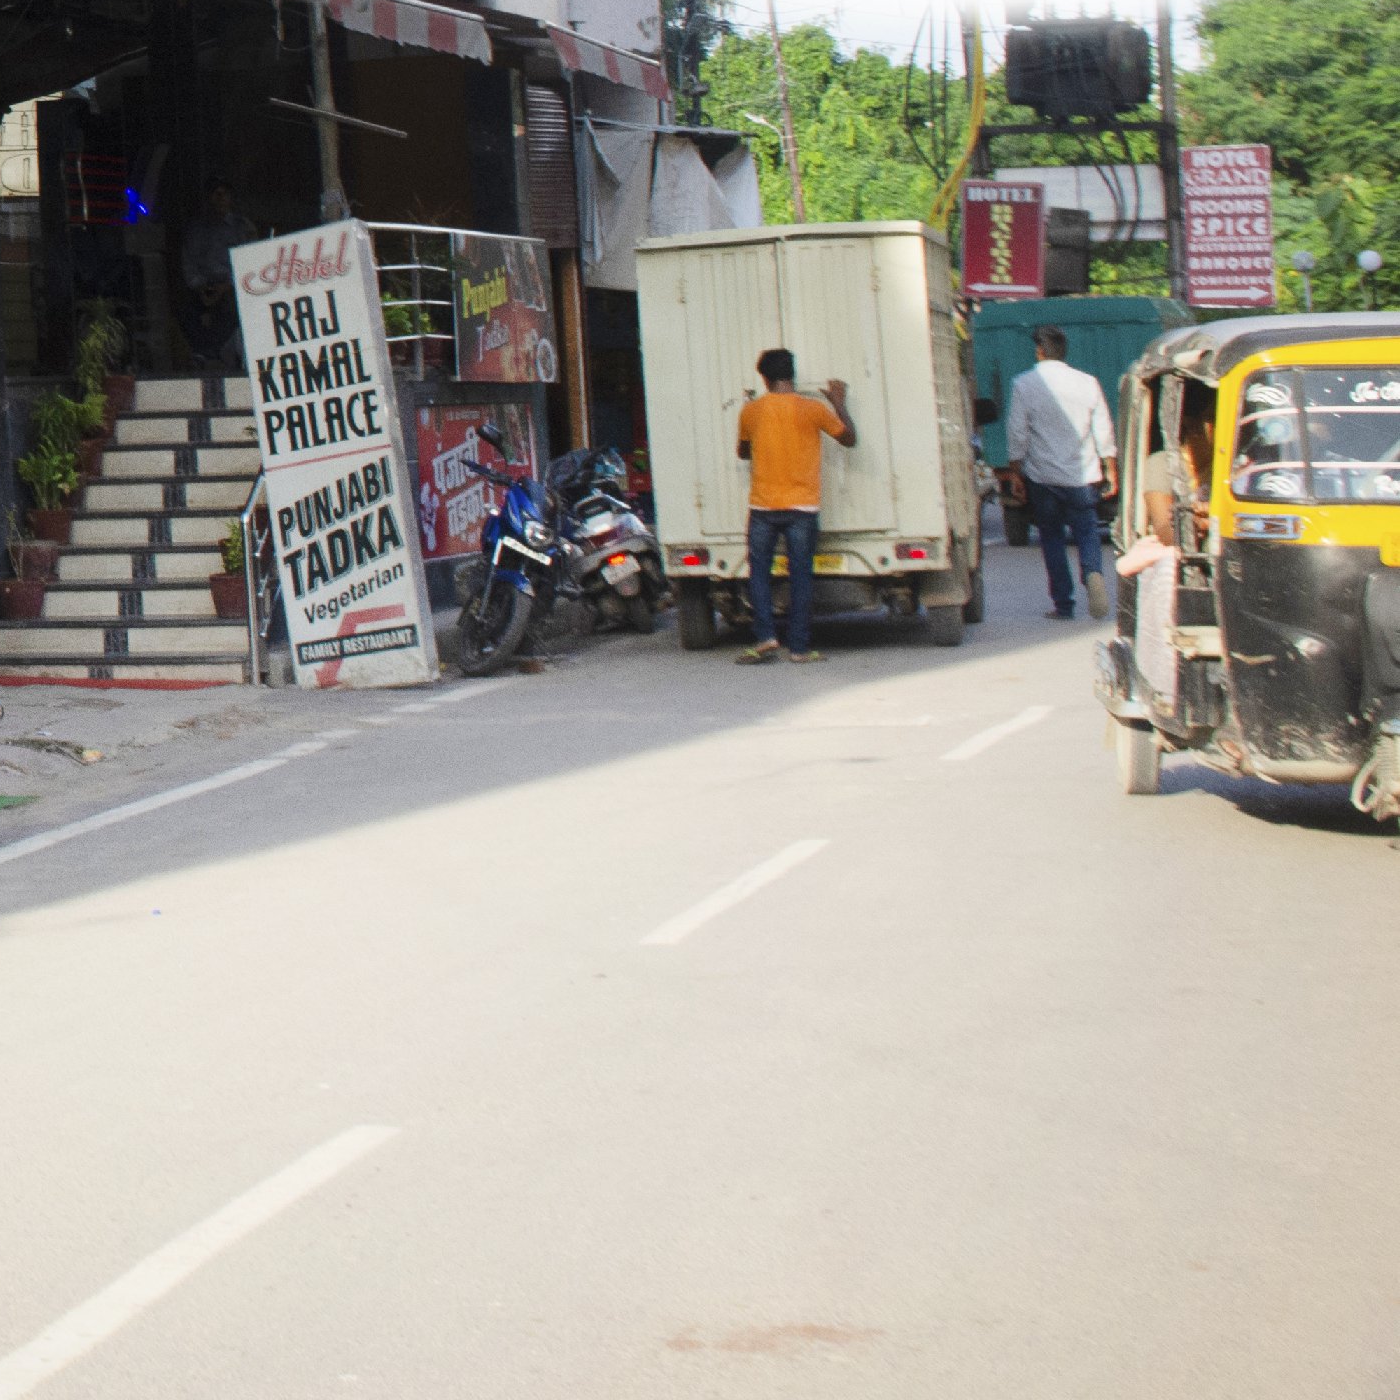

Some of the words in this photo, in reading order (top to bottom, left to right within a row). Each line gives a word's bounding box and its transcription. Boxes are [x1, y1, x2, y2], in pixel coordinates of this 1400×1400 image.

[1191, 150, 1260, 168] HOTEL
[1189, 199, 1266, 215] ROOMS
[1191, 216, 1268, 236] SPICE
[241, 231, 350, 296] Hotel
[1188, 256, 1272, 271] BANQUET
[269, 289, 340, 347] RAJ
[462, 264, 508, 323] Punjabi
[256, 338, 372, 404] KAMAL
[263, 389, 382, 456] PALACE
[277, 455, 394, 548] PUNJABI
[283, 504, 404, 600] TADKA
[304, 562, 404, 625] Vegetarian
[301, 639, 340, 662] FAMILY
[343, 628, 414, 656] RESTAURANT
